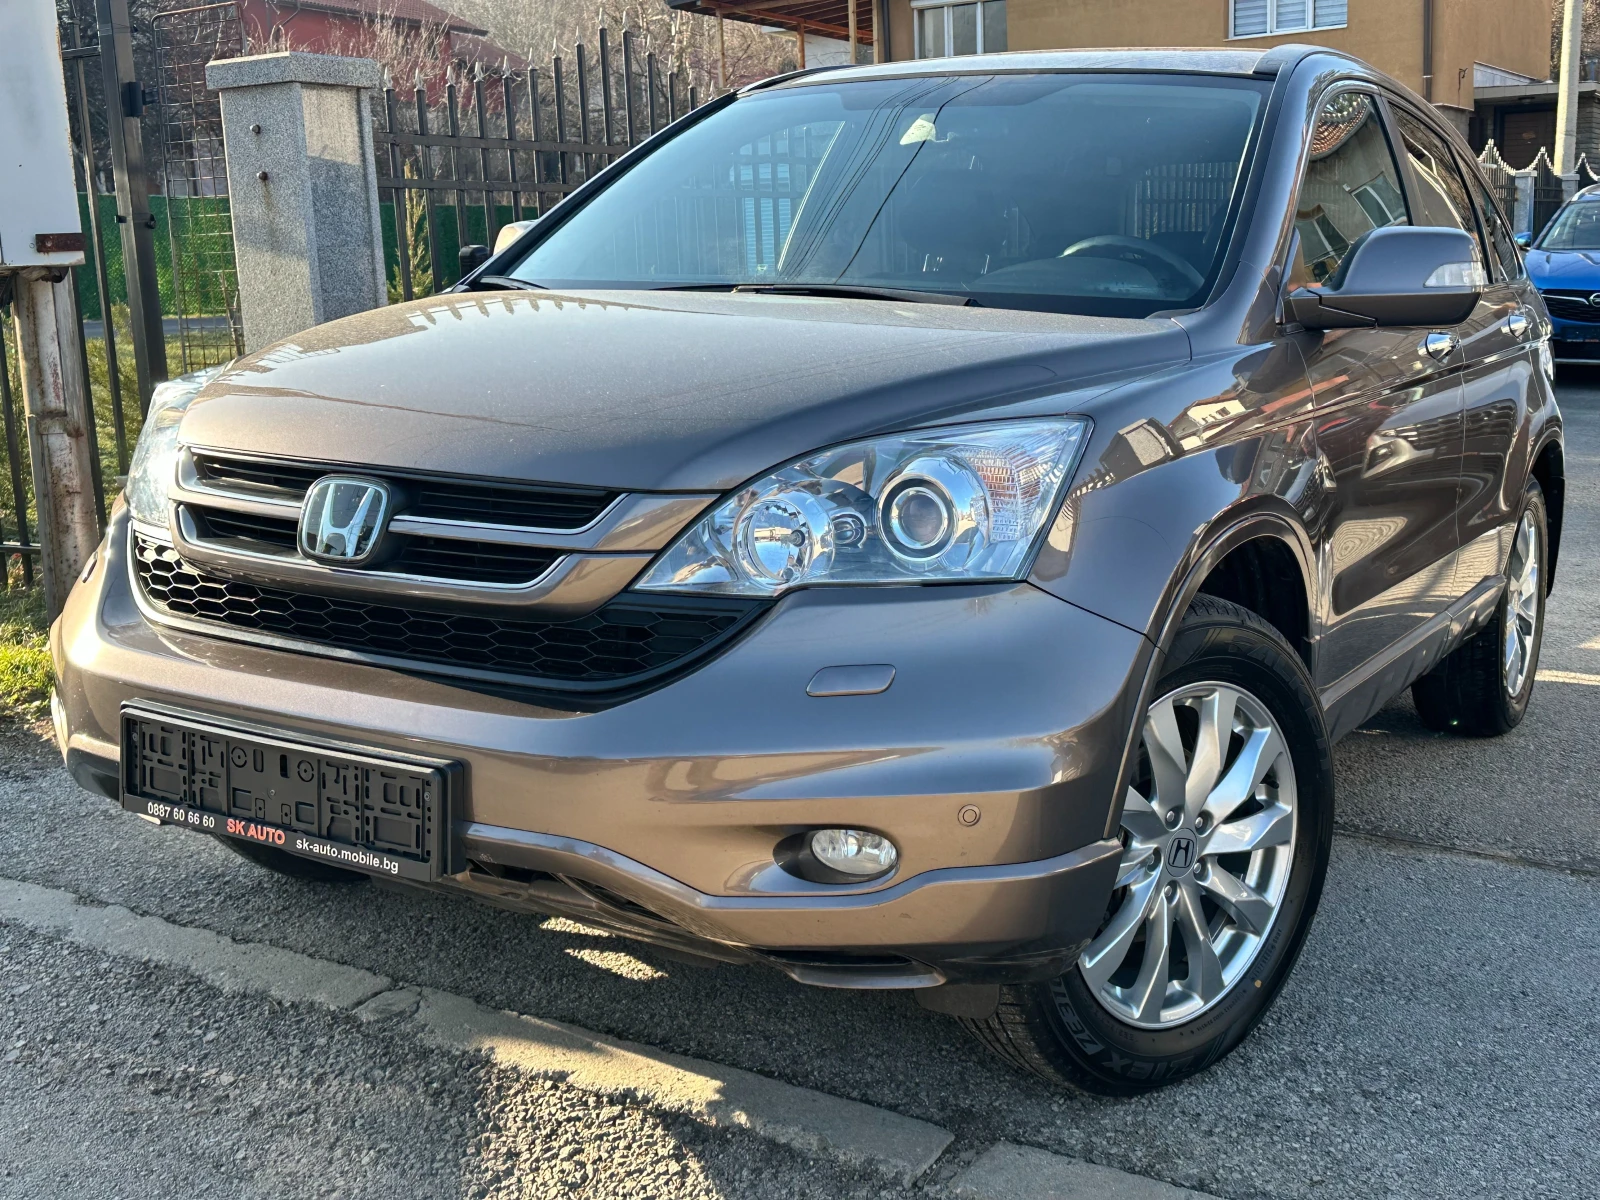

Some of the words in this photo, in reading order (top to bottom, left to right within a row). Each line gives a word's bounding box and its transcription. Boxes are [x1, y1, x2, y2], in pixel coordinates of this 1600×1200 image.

[147, 801, 171, 819] 0887
[173, 807, 185, 821] 60
[187, 811, 200, 825] 66
[202, 814, 215, 828] 60
[226, 818, 246, 836] SK
[246, 822, 286, 845] AUTO
[296, 837, 399, 874] sk-auto.mobile.bg
[1101, 1050, 1196, 1080] ZIEX
